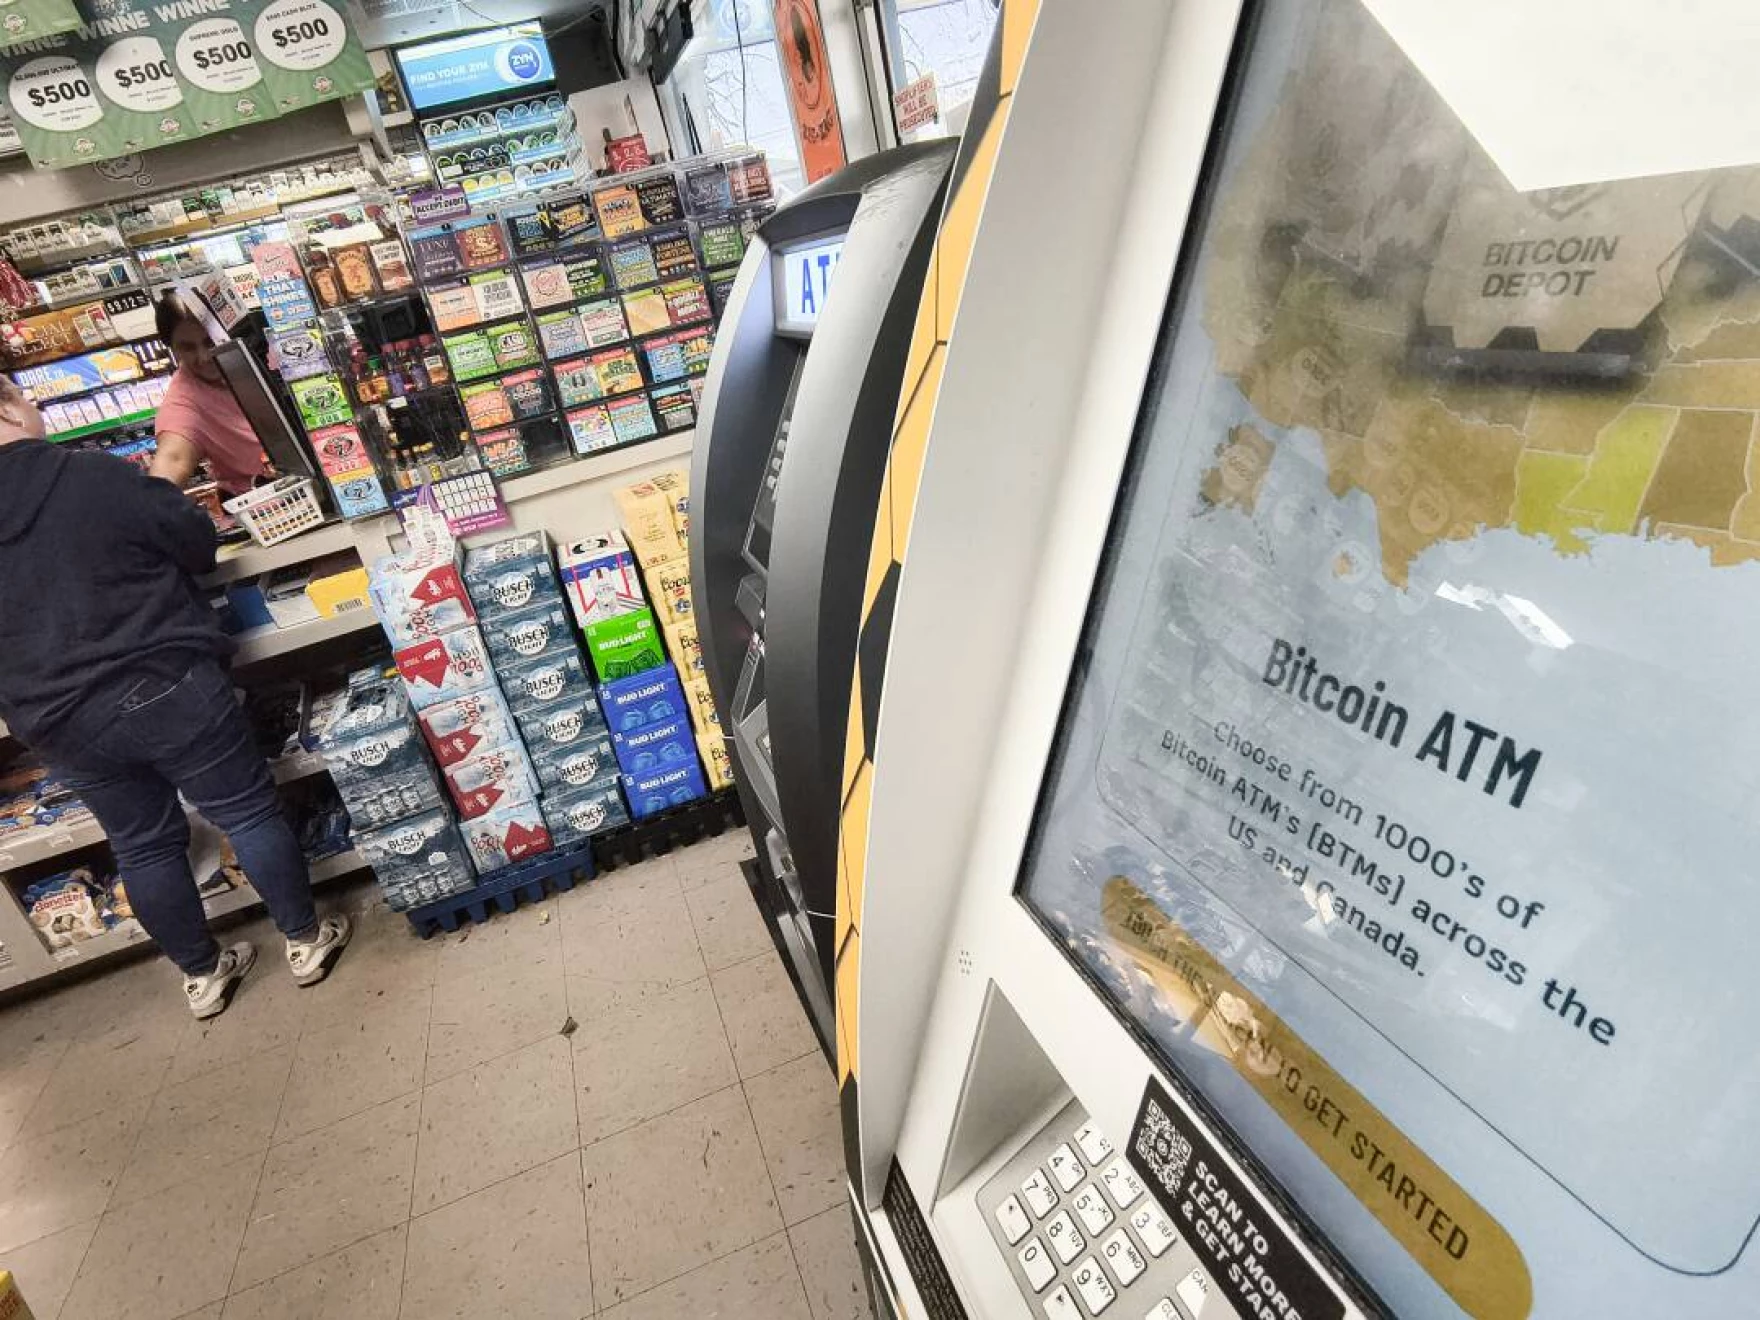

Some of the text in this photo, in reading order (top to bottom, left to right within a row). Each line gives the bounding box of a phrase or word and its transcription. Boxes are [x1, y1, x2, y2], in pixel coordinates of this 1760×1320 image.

[153, 0, 231, 23] WINNE
[77, 10, 150, 41] WINNE
[272, 18, 328, 48] $500
[0, 35, 67, 57] WINNE
[193, 41, 251, 69] $500
[511, 52, 536, 67] ZYN
[28, 79, 91, 107] $500
[1482, 235, 1620, 268] BITCOIN
[801, 253, 839, 314] AT
[1482, 270, 1596, 298] DEPOT
[494, 579, 534, 601] BUSCH
[508, 626, 549, 647] BUSCH
[526, 671, 565, 694] BUSCH
[639, 682, 666, 699] LIGHT
[545, 715, 583, 736] BUSCH
[650, 725, 677, 740] LIGHT
[1262, 638, 1543, 809] Bitcoin ATM
[351, 741, 390, 761] BUSCH
[560, 757, 598, 780] BUSCH
[661, 769, 687, 785] LIGHT
[569, 806, 605, 826] BUSCH
[1213, 720, 1545, 930] Choose from 1000's of
[388, 830, 426, 849] BUSCH
[1161, 729, 1226, 787] Bitcoin
[1231, 775, 1299, 835] ATM's
[1411, 894, 1527, 987] across
[1542, 977, 1616, 1047] the
[1228, 814, 1427, 977] US and Canada.
[1052, 1156, 1064, 1168] 4
[1025, 1178, 1039, 1191] 7
[1105, 1168, 1119, 1184] 2
[1303, 1085, 1349, 1139] GET
[1350, 1131, 1471, 1262] STARTED
[1077, 1194, 1091, 1210] 5
[1195, 1161, 1269, 1255] SCAN TO
[1135, 1211, 1150, 1229] 3
[1188, 1180, 1245, 1256] LEARN
[1049, 1221, 1063, 1238] 8
[1024, 1246, 1037, 1262] 0
[1106, 1241, 1121, 1258] 6
[1181, 1200, 1277, 1320] & GET STAR
[1076, 1269, 1091, 1285] 9
